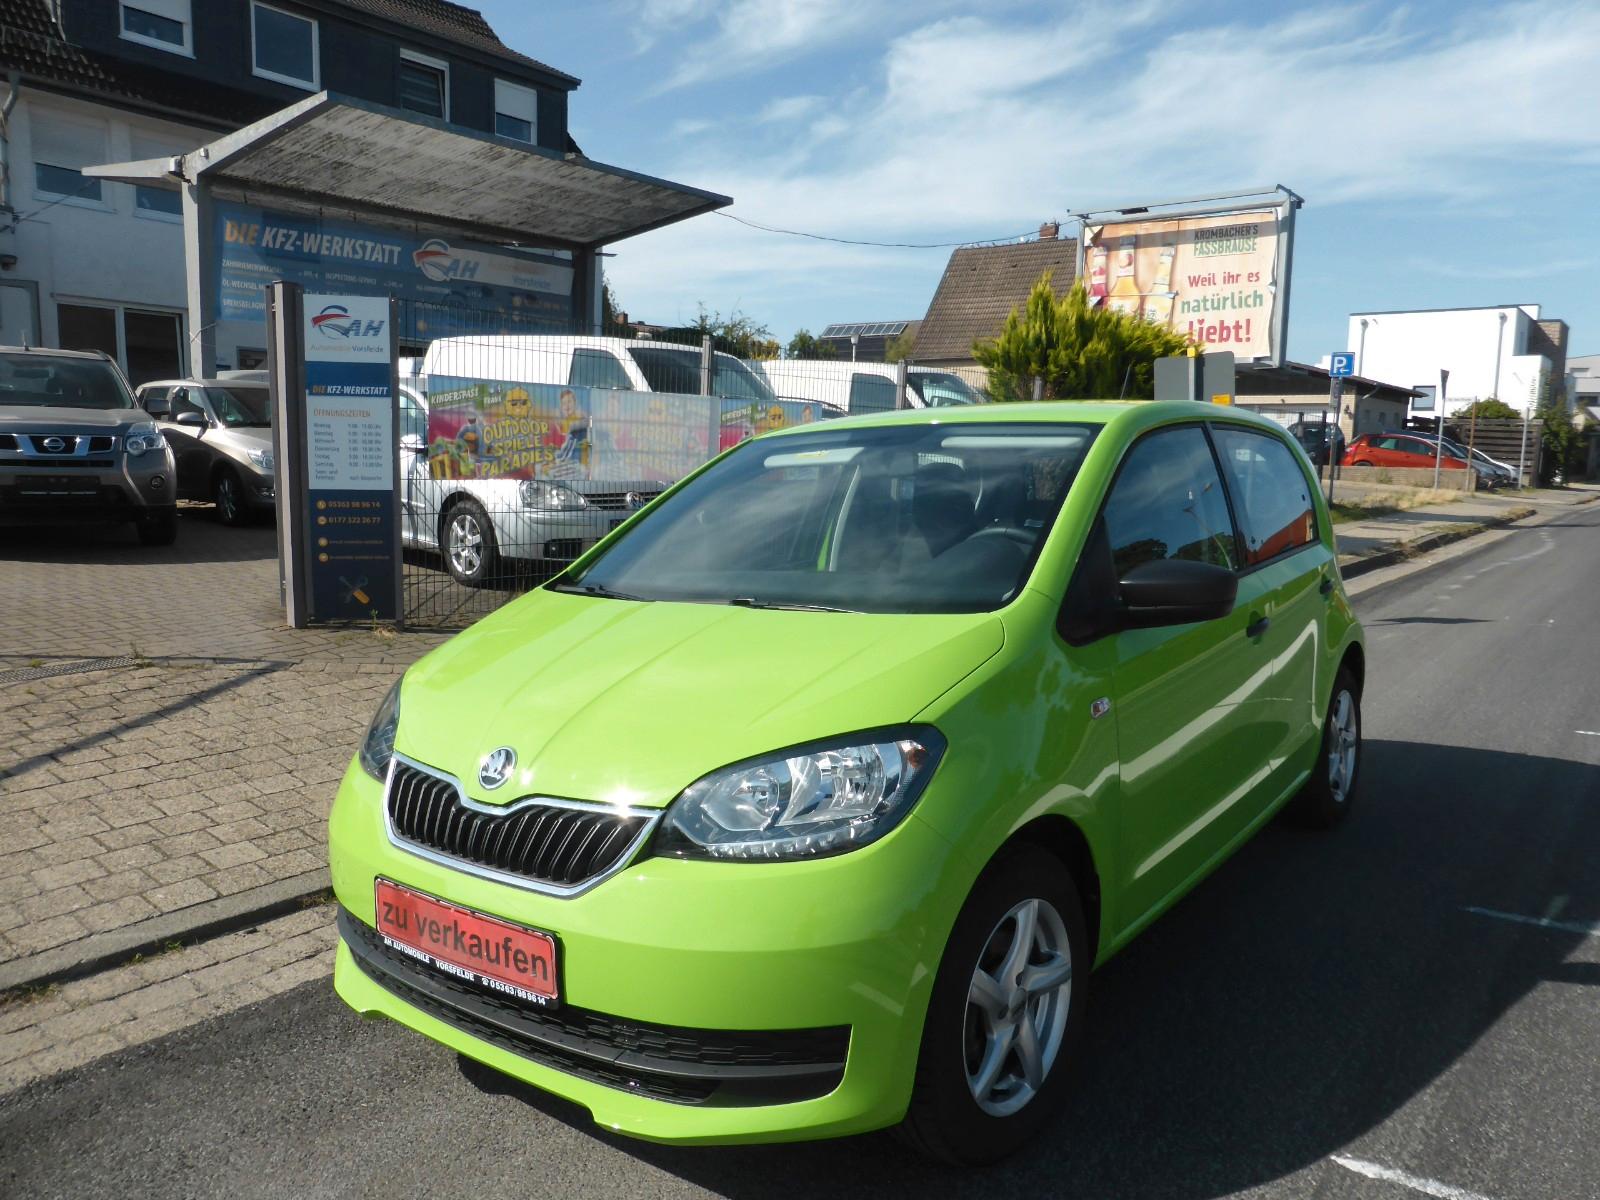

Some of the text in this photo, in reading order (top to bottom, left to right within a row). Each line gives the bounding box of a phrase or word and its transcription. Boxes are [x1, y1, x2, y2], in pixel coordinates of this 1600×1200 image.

[225, 221, 401, 264] DIE KFZ-WERKSTATT
[1194, 225, 1258, 241] KROMBACHER'S
[1193, 238, 1257, 256] FASSBRAUSE
[1188, 271, 1260, 288] Weil ihr es
[1181, 290, 1264, 314] natürlich
[345, 319, 385, 337] AH
[1333, 356, 1347, 374] P
[327, 385, 388, 395] KFZ-WERKSTATT
[483, 419, 549, 444] OUTDOOR
[494, 434, 541, 457] SPIELE
[481, 450, 554, 477] PARADIES
[382, 901, 548, 981] zu verkaufen
[393, 941, 430, 964] AUTOMOBILE
[435, 960, 475, 982] VORSFELDE
